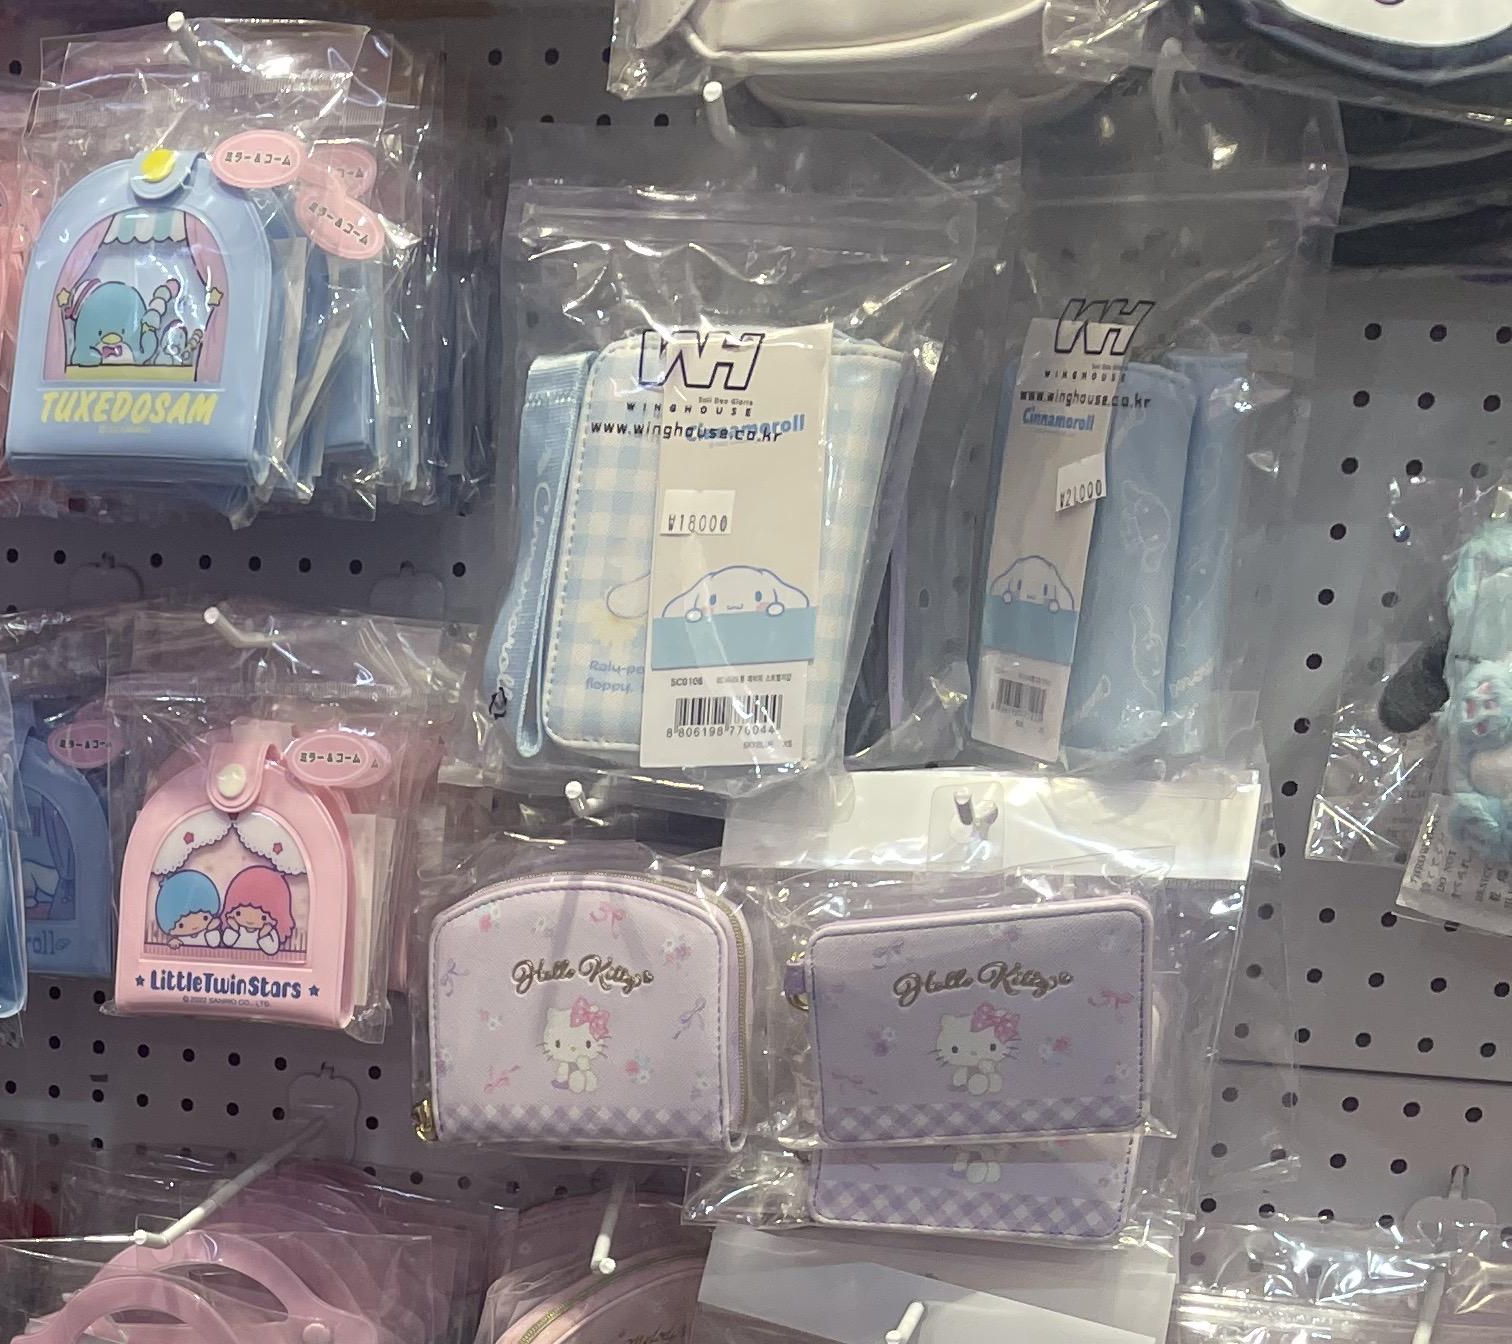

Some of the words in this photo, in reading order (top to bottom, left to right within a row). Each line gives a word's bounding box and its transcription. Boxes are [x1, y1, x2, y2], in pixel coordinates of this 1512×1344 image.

[41, 390, 218, 425] TUXEDOSAM
[1023, 406, 1095, 431] Cinnamoroll
[512, 958, 576, 995] Hello
[578, 953, 643, 995] Kitty
[893, 968, 974, 1007] Hello
[977, 961, 1058, 999] Kitty
